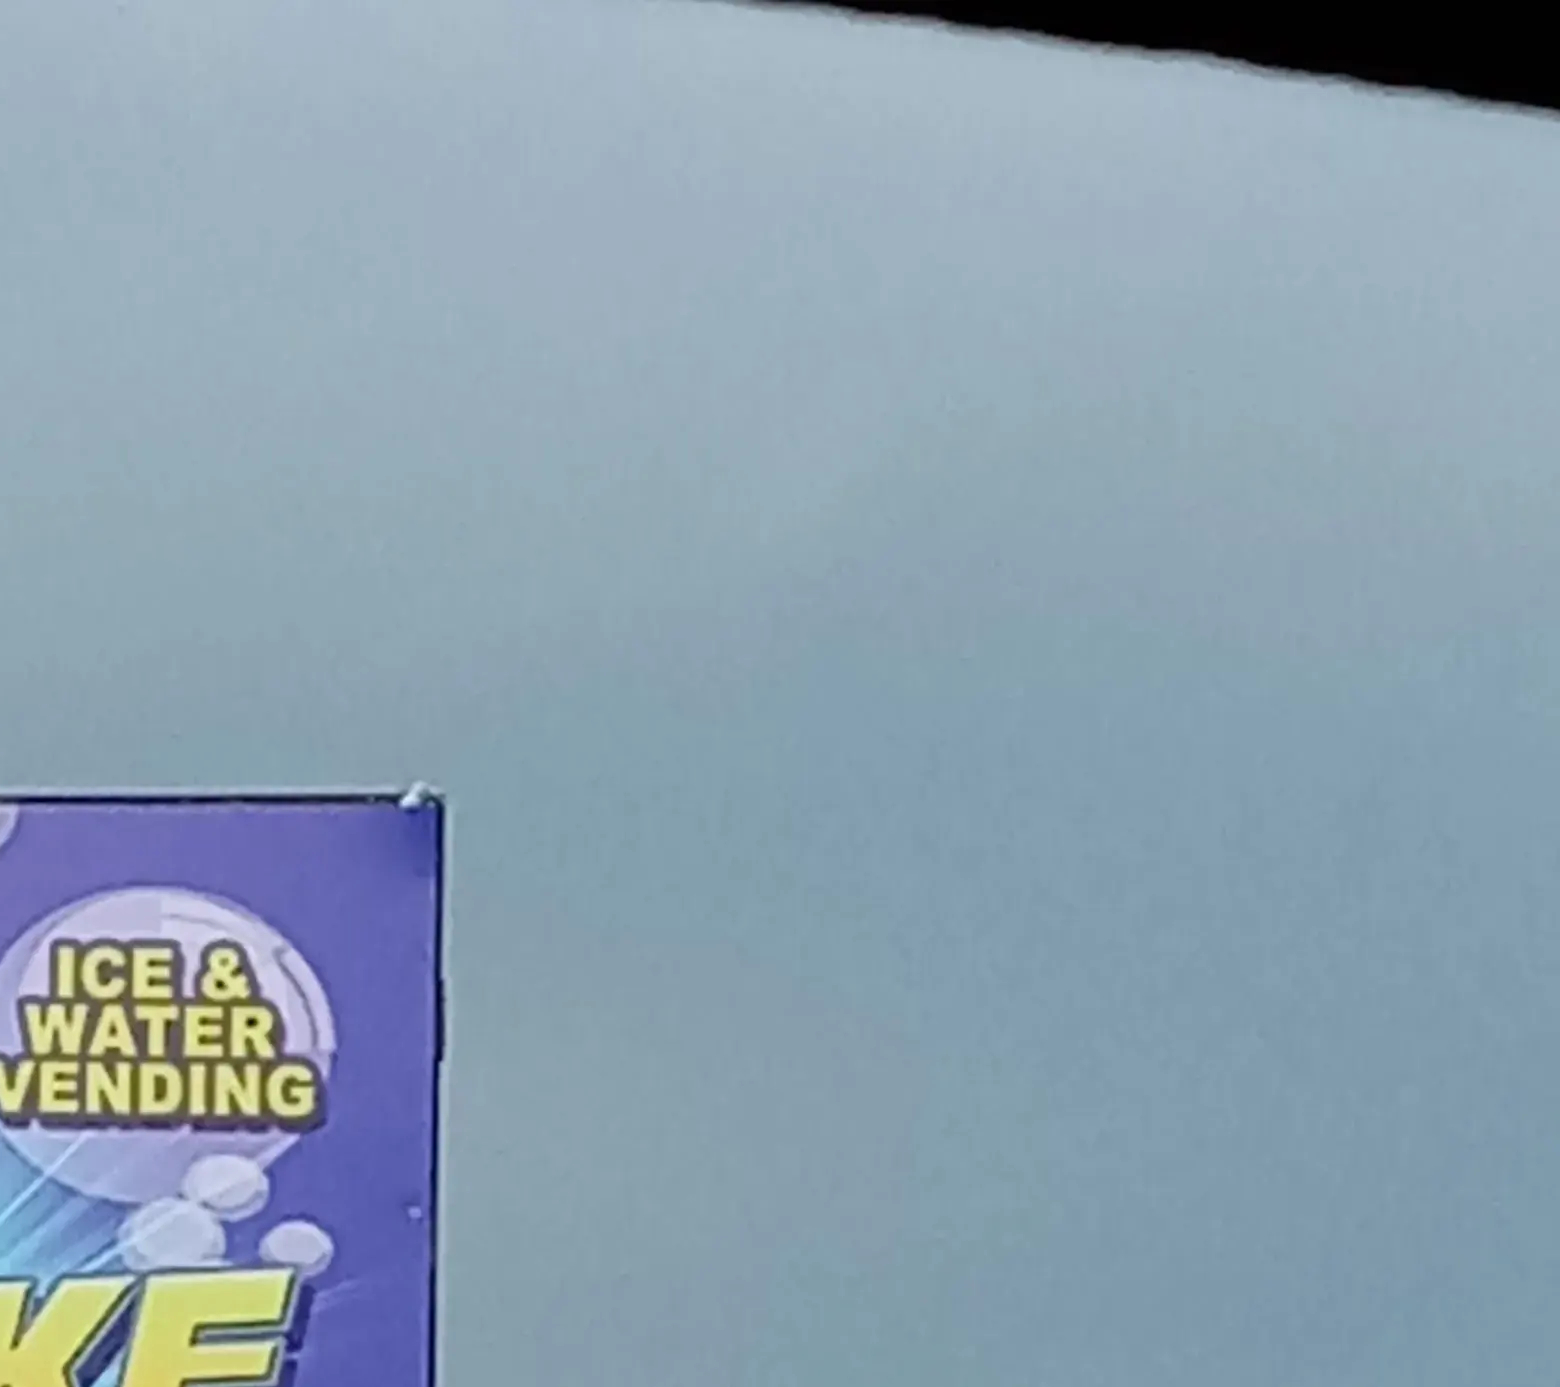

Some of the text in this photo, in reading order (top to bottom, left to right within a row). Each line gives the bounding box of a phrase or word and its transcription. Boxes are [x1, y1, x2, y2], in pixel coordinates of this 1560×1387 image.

[51, 943, 253, 1000] ICE &
[20, 1006, 279, 1061] WATER
